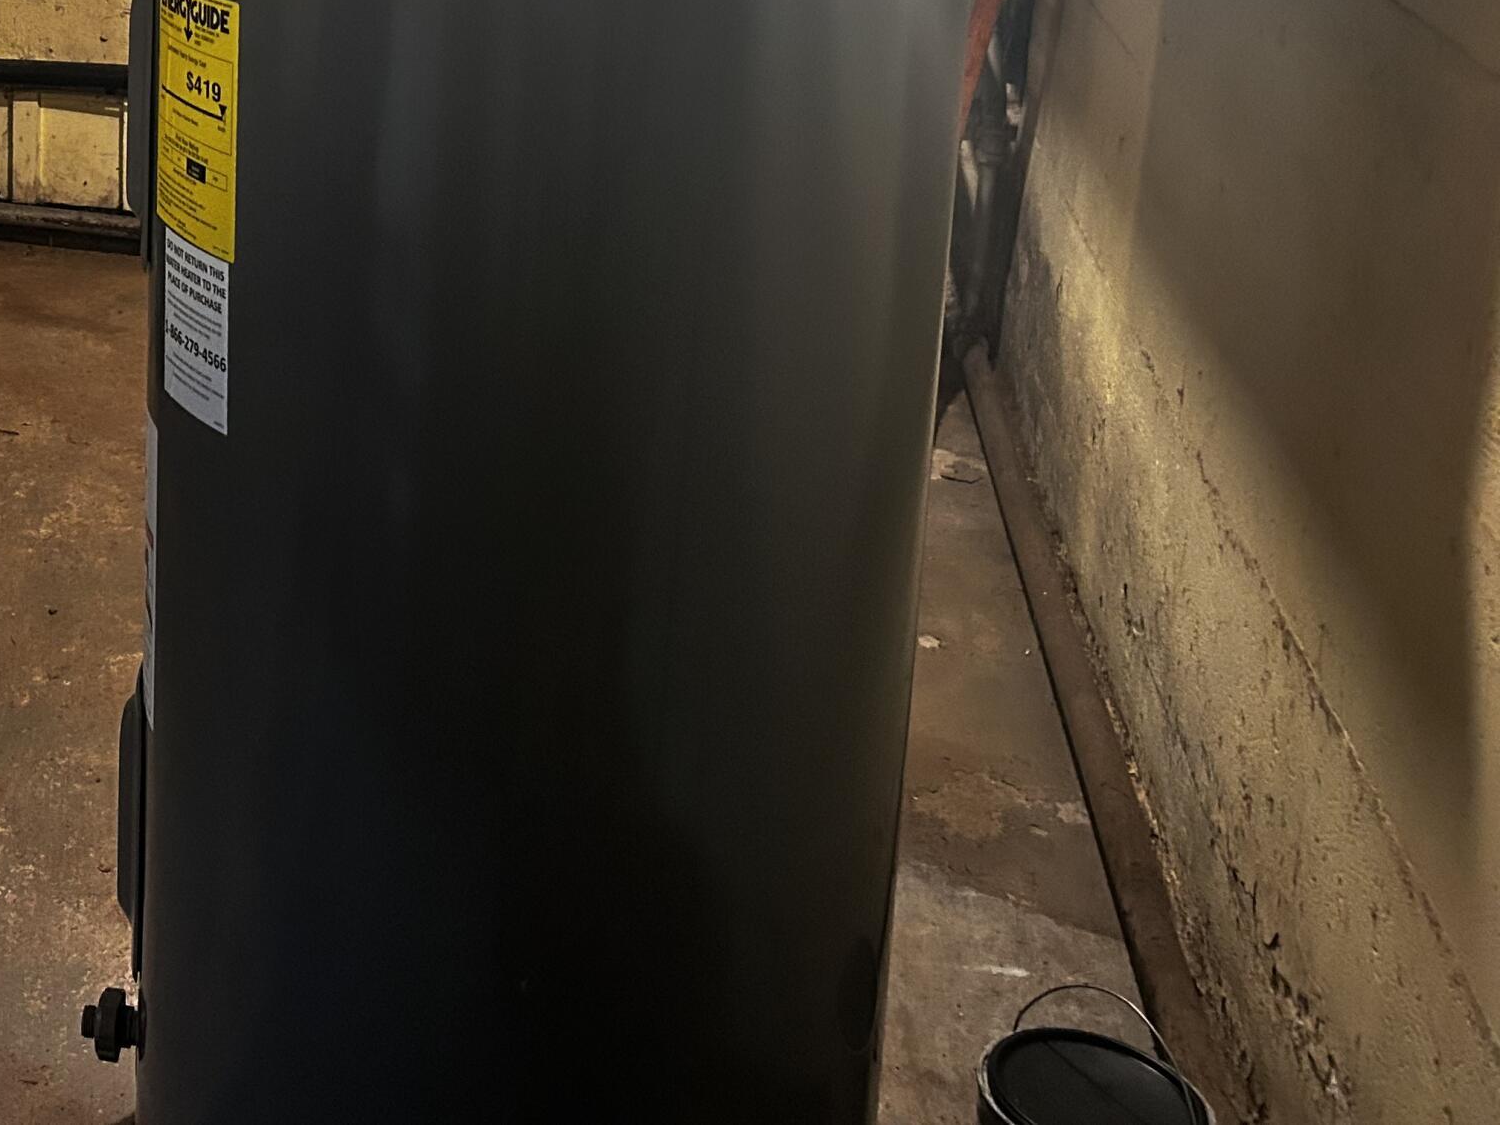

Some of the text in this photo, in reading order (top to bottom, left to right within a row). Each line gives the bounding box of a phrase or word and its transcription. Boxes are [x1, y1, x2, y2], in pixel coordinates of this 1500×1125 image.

[186, 71, 222, 103] $419
[185, 251, 208, 274] RETURN
[209, 265, 225, 282] THIS
[181, 281, 189, 294] OF
[189, 286, 222, 315] PURCHASE
[202, 278, 211, 292] TO
[212, 283, 227, 300] THE
